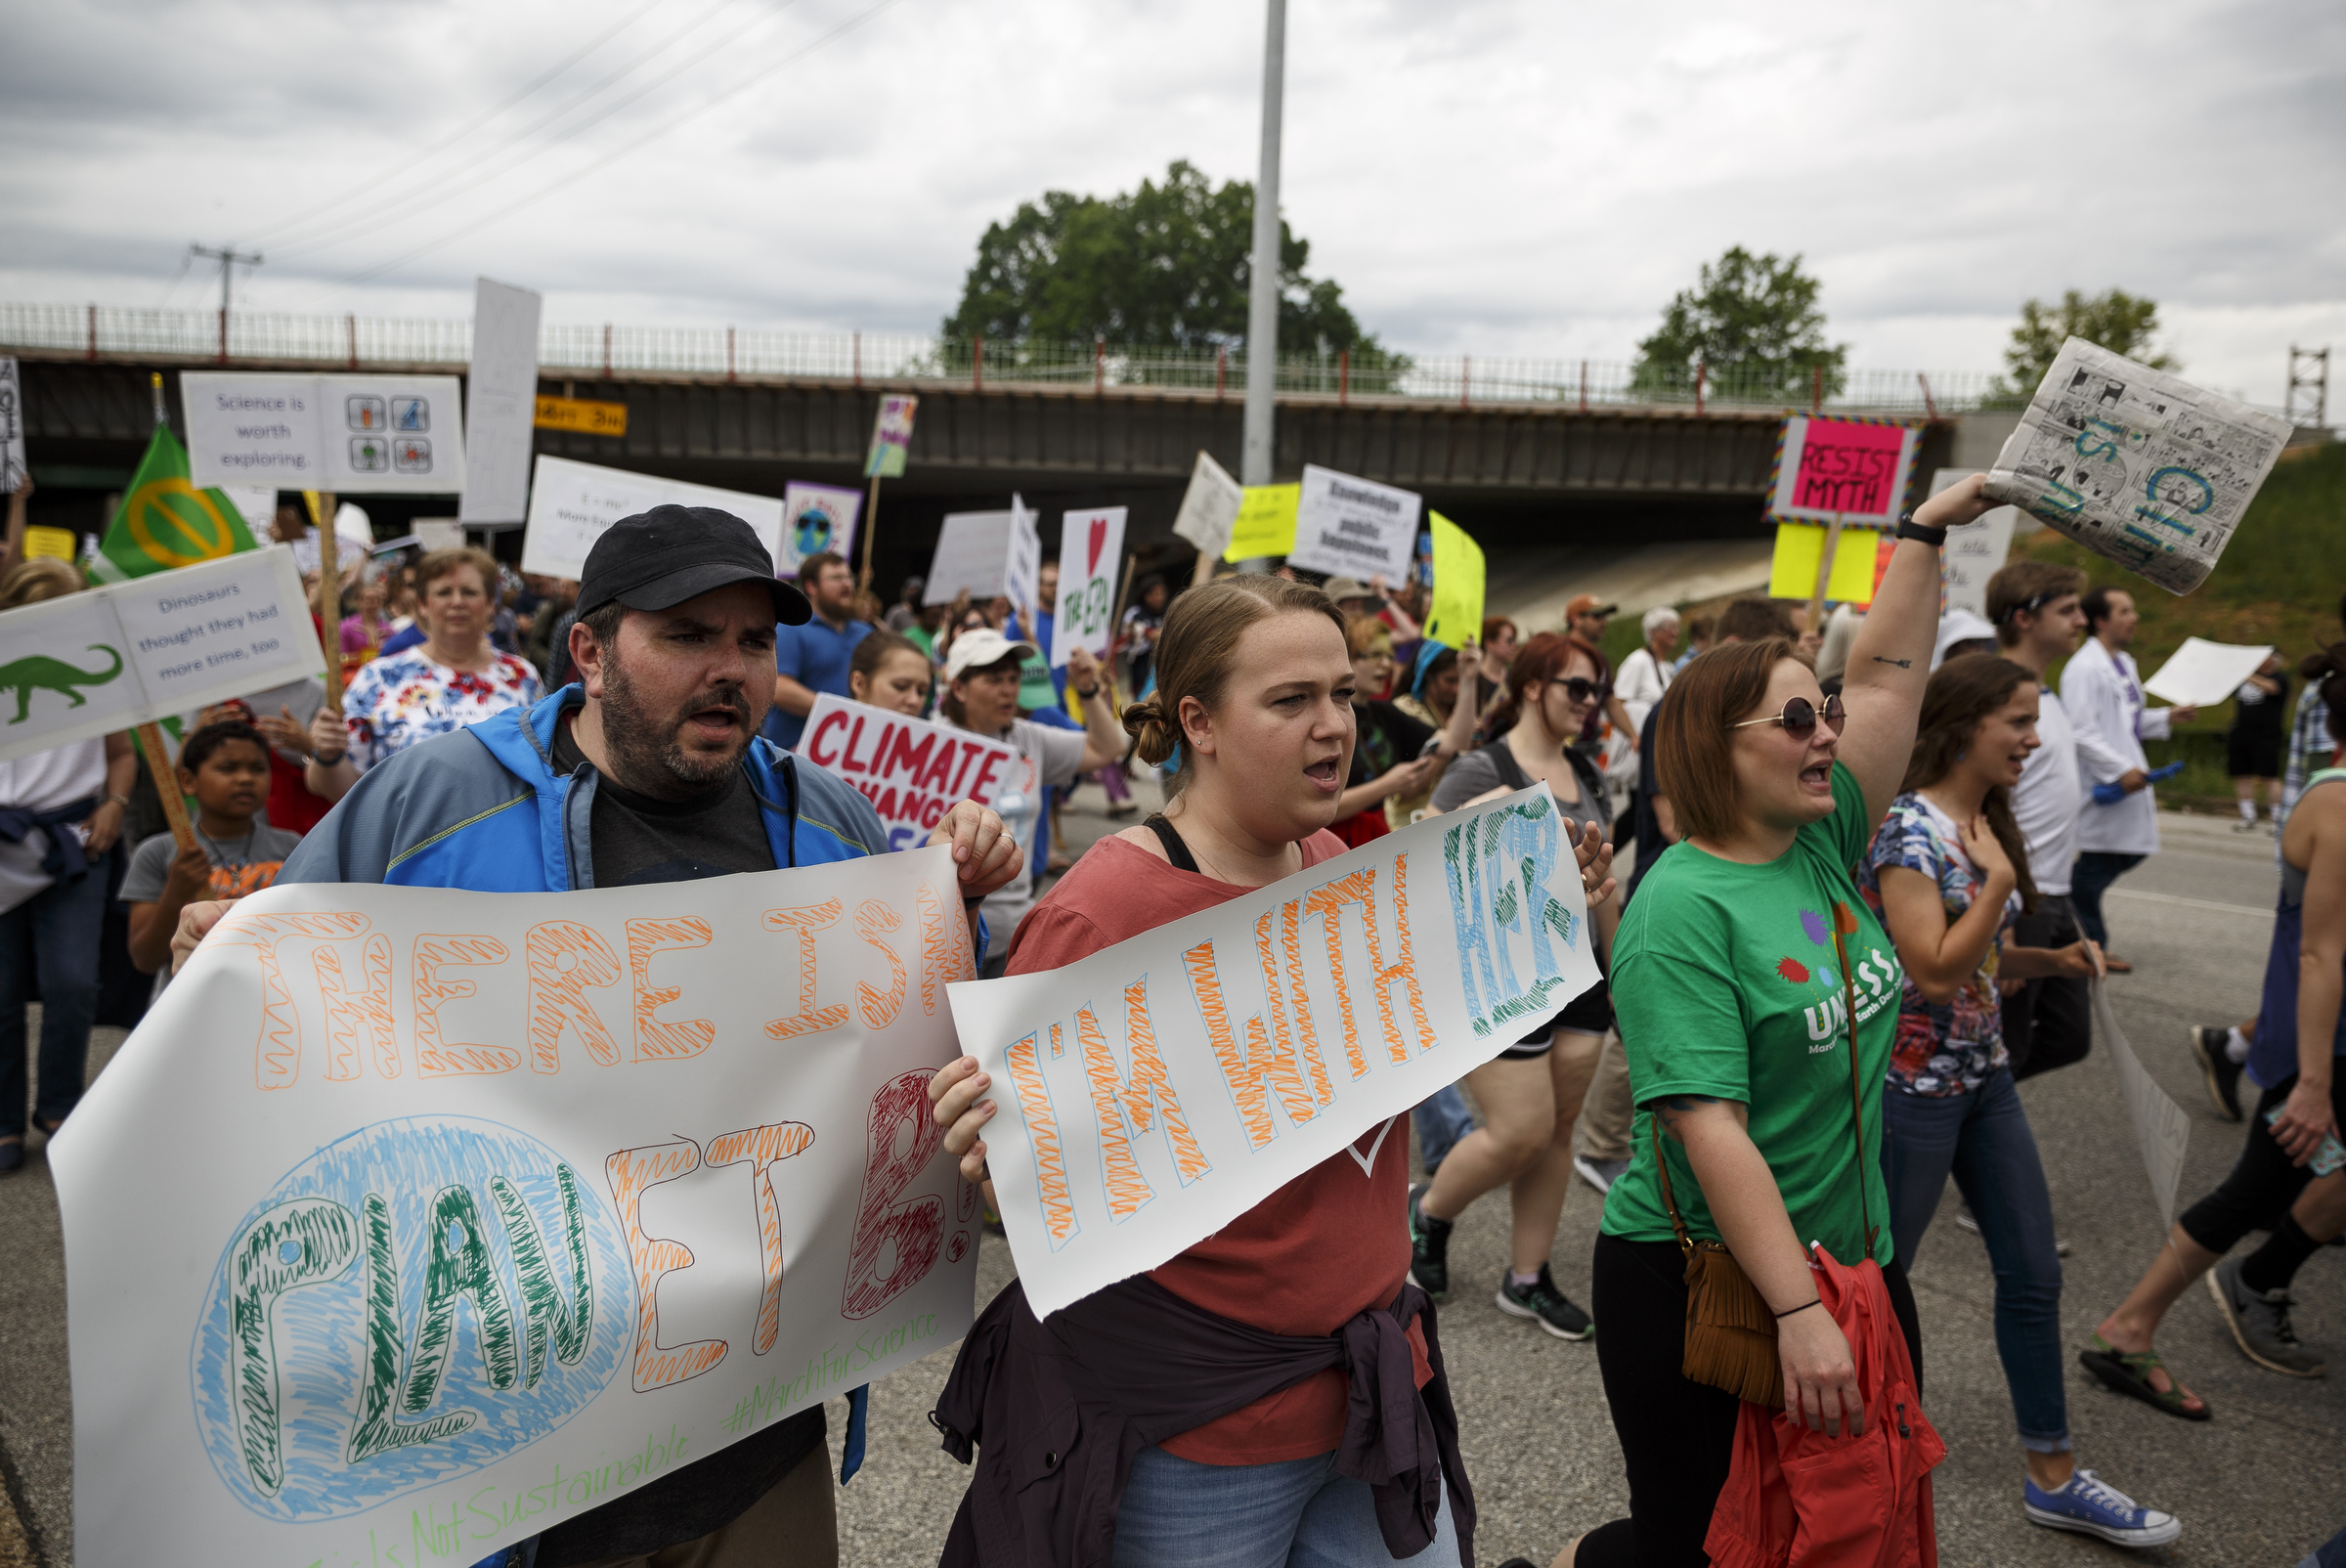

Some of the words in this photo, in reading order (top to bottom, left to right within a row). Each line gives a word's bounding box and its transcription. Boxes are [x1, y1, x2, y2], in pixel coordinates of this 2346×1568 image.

[216, 393, 286, 412] Science
[290, 395, 306, 412] is
[234, 424, 291, 440] worth
[219, 449, 311, 470] exploring.
[1800, 442, 1902, 484] RESIST
[1803, 477, 1881, 513] MYTH
[158, 583, 241, 615] Dinosaurs
[139, 625, 206, 653] thought
[208, 616, 245, 636] they
[247, 602, 280, 624] had
[159, 659, 204, 680] more
[205, 647, 249, 669] time,
[250, 637, 281, 656] too
[808, 710, 1010, 806] CLIMATE
[842, 777, 959, 830] HANG
[196, 912, 716, 1092] THERE
[761, 896, 908, 1037] IS
[1854, 1001, 1882, 1024] Earth
[1878, 987, 1895, 1007] Day
[1004, 973, 1213, 1254] I'M
[1180, 849, 1440, 1154] WITH
[1443, 793, 1581, 1041] HER
[228, 1120, 815, 1499] PLANET
[718, 1312, 939, 1435] #MarchForScience
